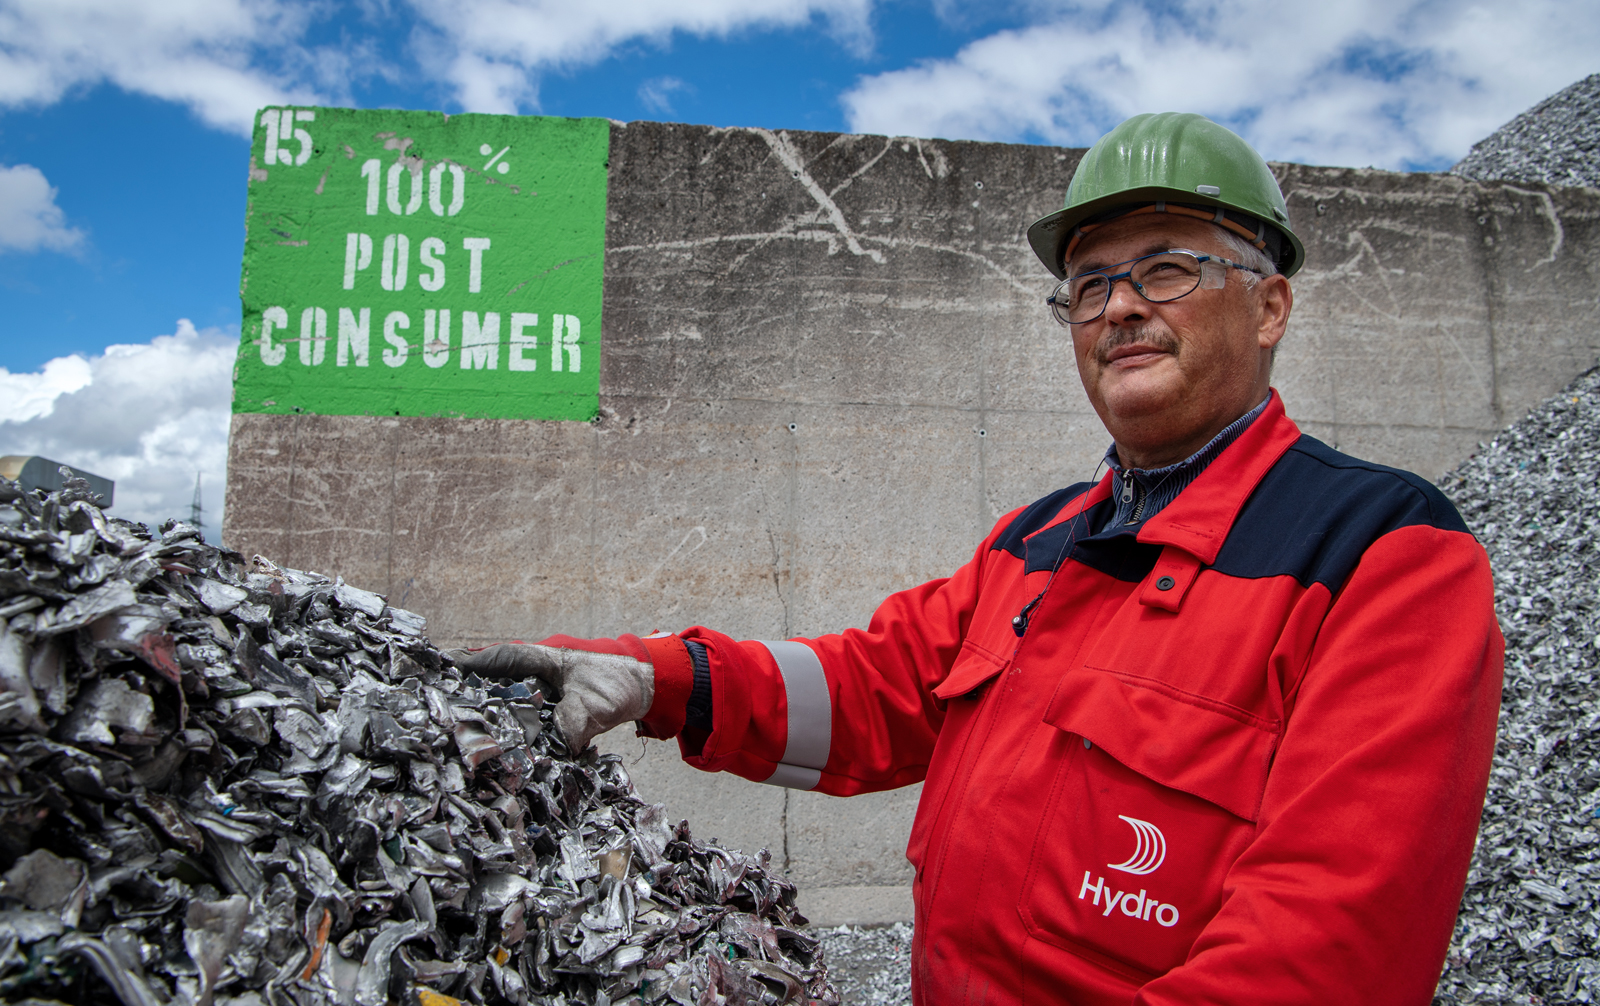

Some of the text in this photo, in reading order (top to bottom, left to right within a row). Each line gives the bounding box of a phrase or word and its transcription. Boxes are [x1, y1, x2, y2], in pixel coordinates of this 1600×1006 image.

[260, 109, 315, 166] 15
[343, 232, 491, 293] POST
[259, 306, 582, 373] CONSUMER
[1078, 870, 1180, 928] Hydro
